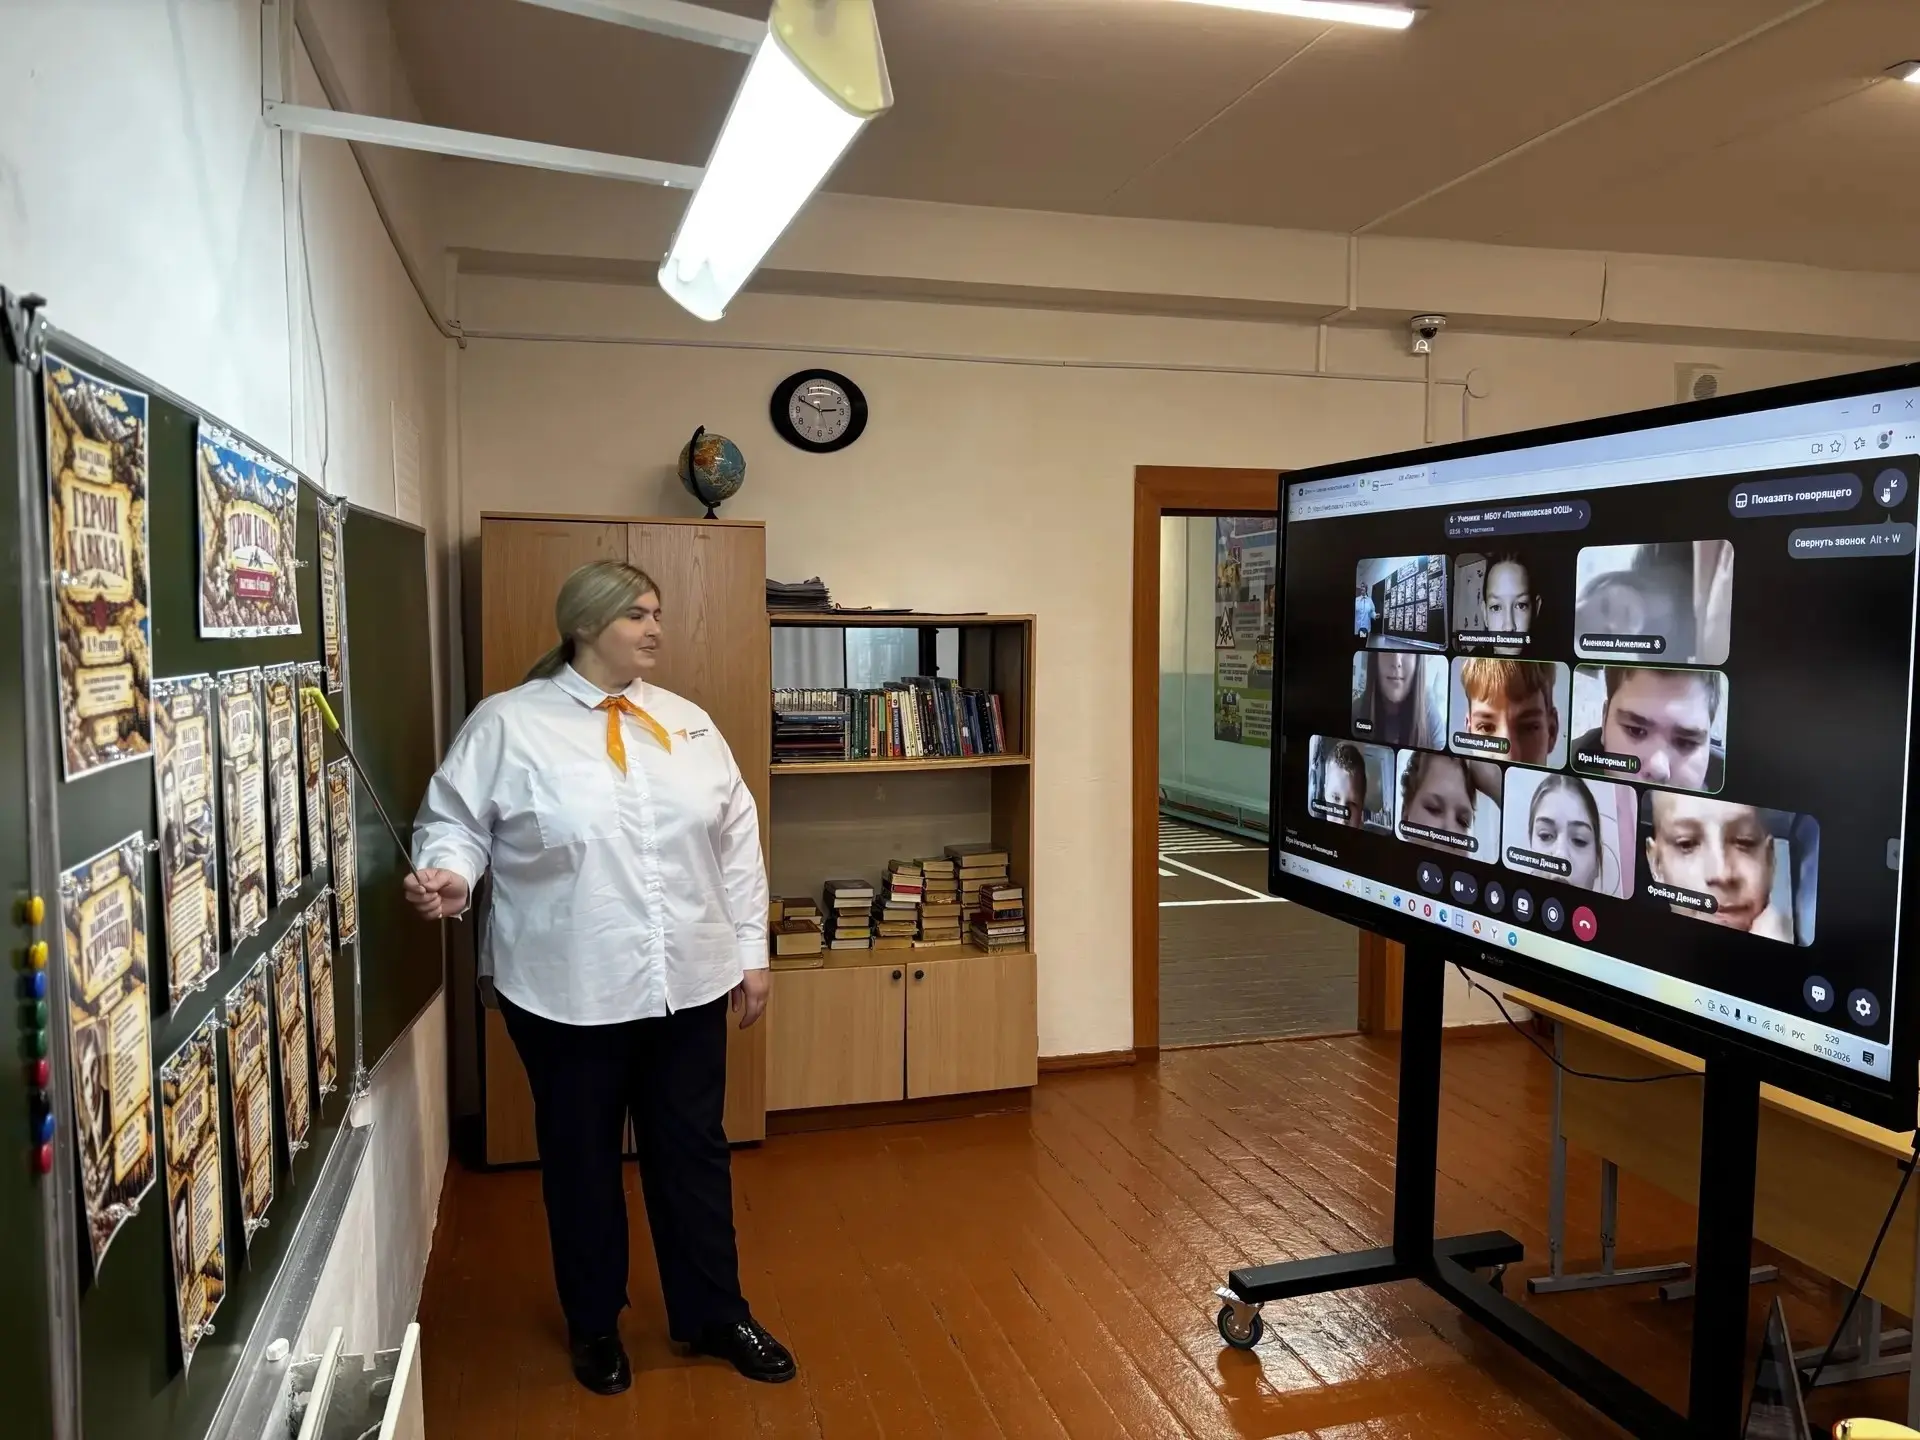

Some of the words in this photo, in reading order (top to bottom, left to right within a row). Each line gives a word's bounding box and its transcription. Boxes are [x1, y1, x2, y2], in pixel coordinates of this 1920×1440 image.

[836, 396, 842, 405] 2
[795, 405, 801, 414] 9
[839, 408, 845, 416] 3
[798, 417, 804, 425] 8
[806, 426, 812, 434] 7
[1751, 494, 1794, 505] Показать
[1795, 487, 1852, 501] говорящего
[72, 487, 118, 535] ГЕРОИ
[1457, 515, 1480, 523] Ученики
[1484, 511, 1502, 521] МБОУ
[1502, 507, 1552, 519] «Плотниковская
[1553, 505, 1573, 515] ООШ»
[1795, 538, 1834, 549] Свернуть
[1835, 536, 1866, 546] звонок
[1869, 534, 1882, 544] Alt
[1892, 533, 1901, 543] W
[67, 530, 129, 581] КАВКАЗА
[1582, 637, 1614, 648] Аненкова
[1615, 638, 1651, 649] Анжелика
[1483, 739, 1499, 749] Дима
[1578, 752, 1592, 763] Юра
[1593, 754, 1627, 767] Нагорных
[1429, 831, 1450, 843] Ярослав
[1450, 836, 1468, 847] Новый
[1508, 850, 1540, 865] Карапетян
[1540, 858, 1559, 870] Диана
[1647, 884, 1676, 899] Фрейзе
[1676, 891, 1701, 906] Денис
[1791, 1029, 1806, 1041] РУС
[1824, 1033, 1840, 1045] 5:29
[1813, 1043, 1851, 1063] 09.10.2026
